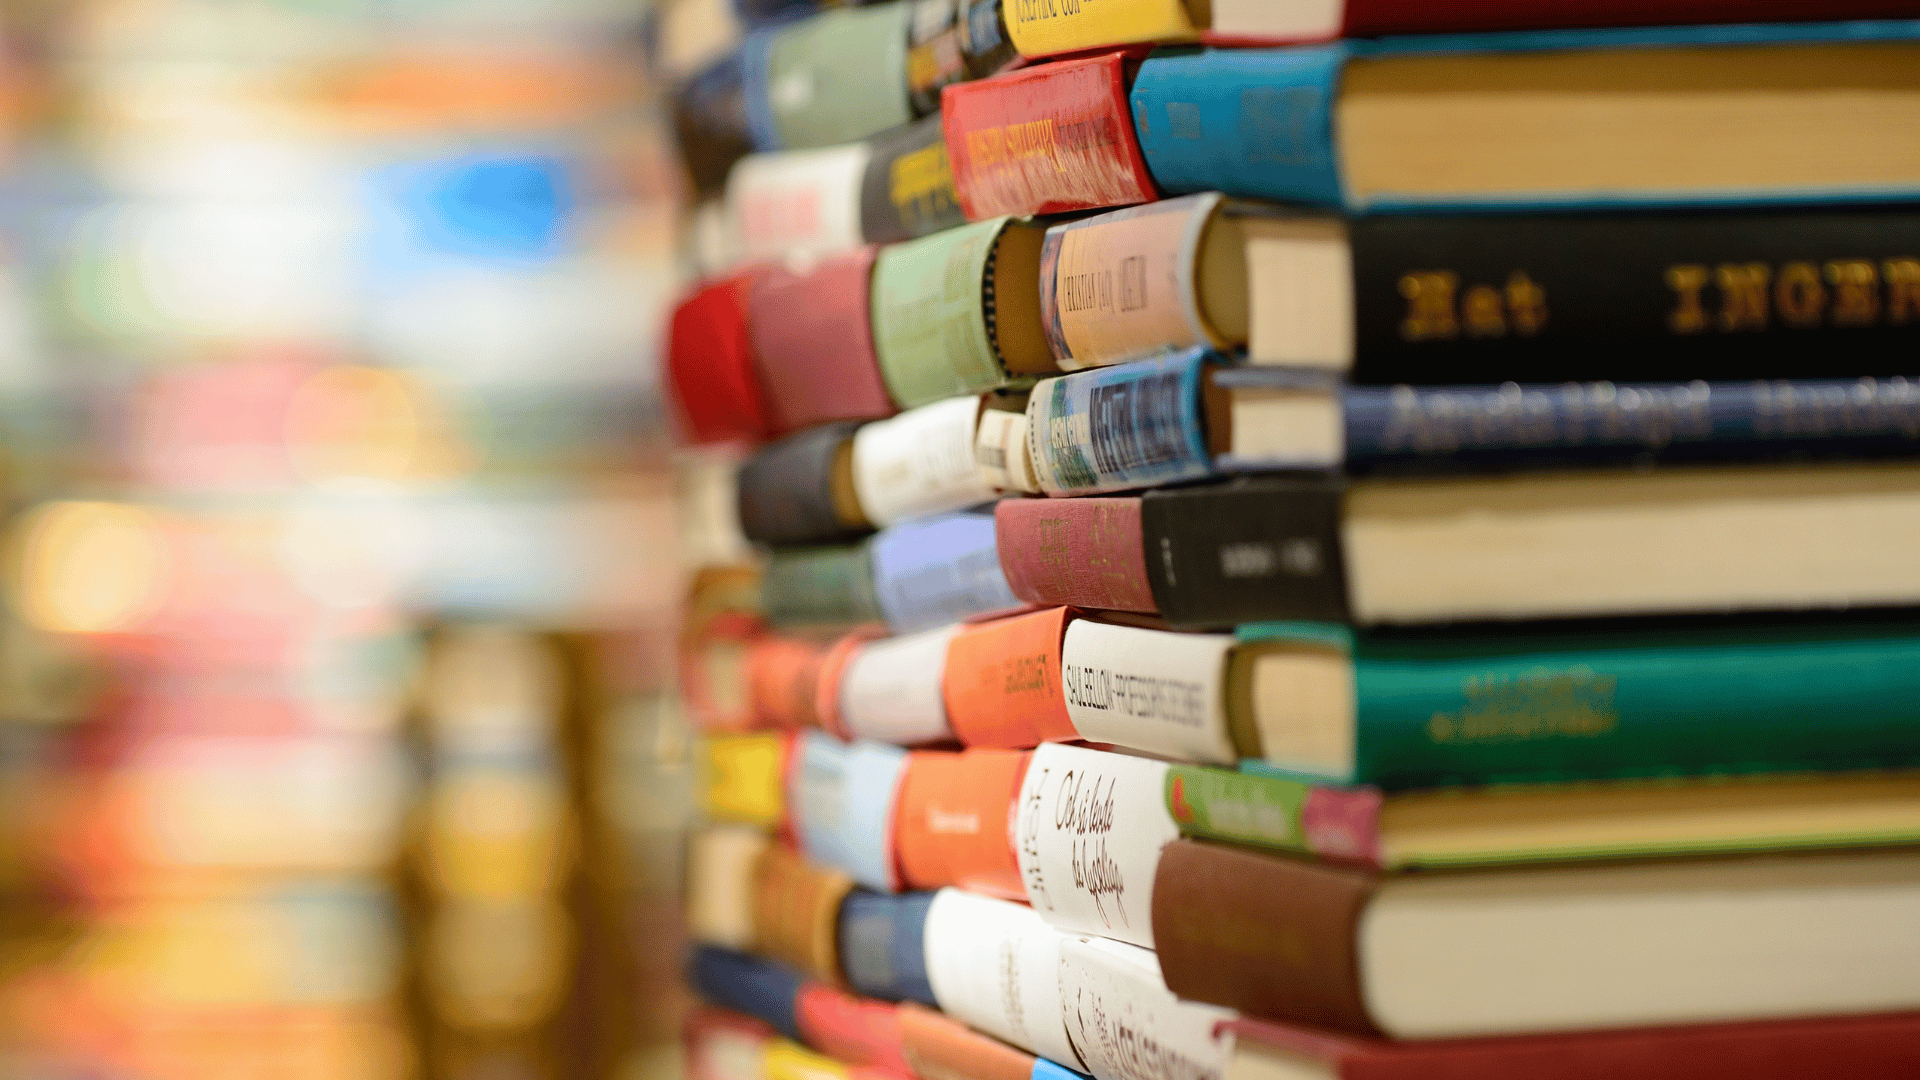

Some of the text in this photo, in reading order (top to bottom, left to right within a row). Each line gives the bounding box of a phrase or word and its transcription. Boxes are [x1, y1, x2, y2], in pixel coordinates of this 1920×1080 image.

[1064, 273, 1096, 312] CHRISTIAN
[1066, 664, 1086, 707] SAUL
[1055, 769, 1084, 834] Och
[1077, 789, 1090, 836] så
[1089, 774, 1117, 836] levde
[1071, 839, 1084, 889] de
